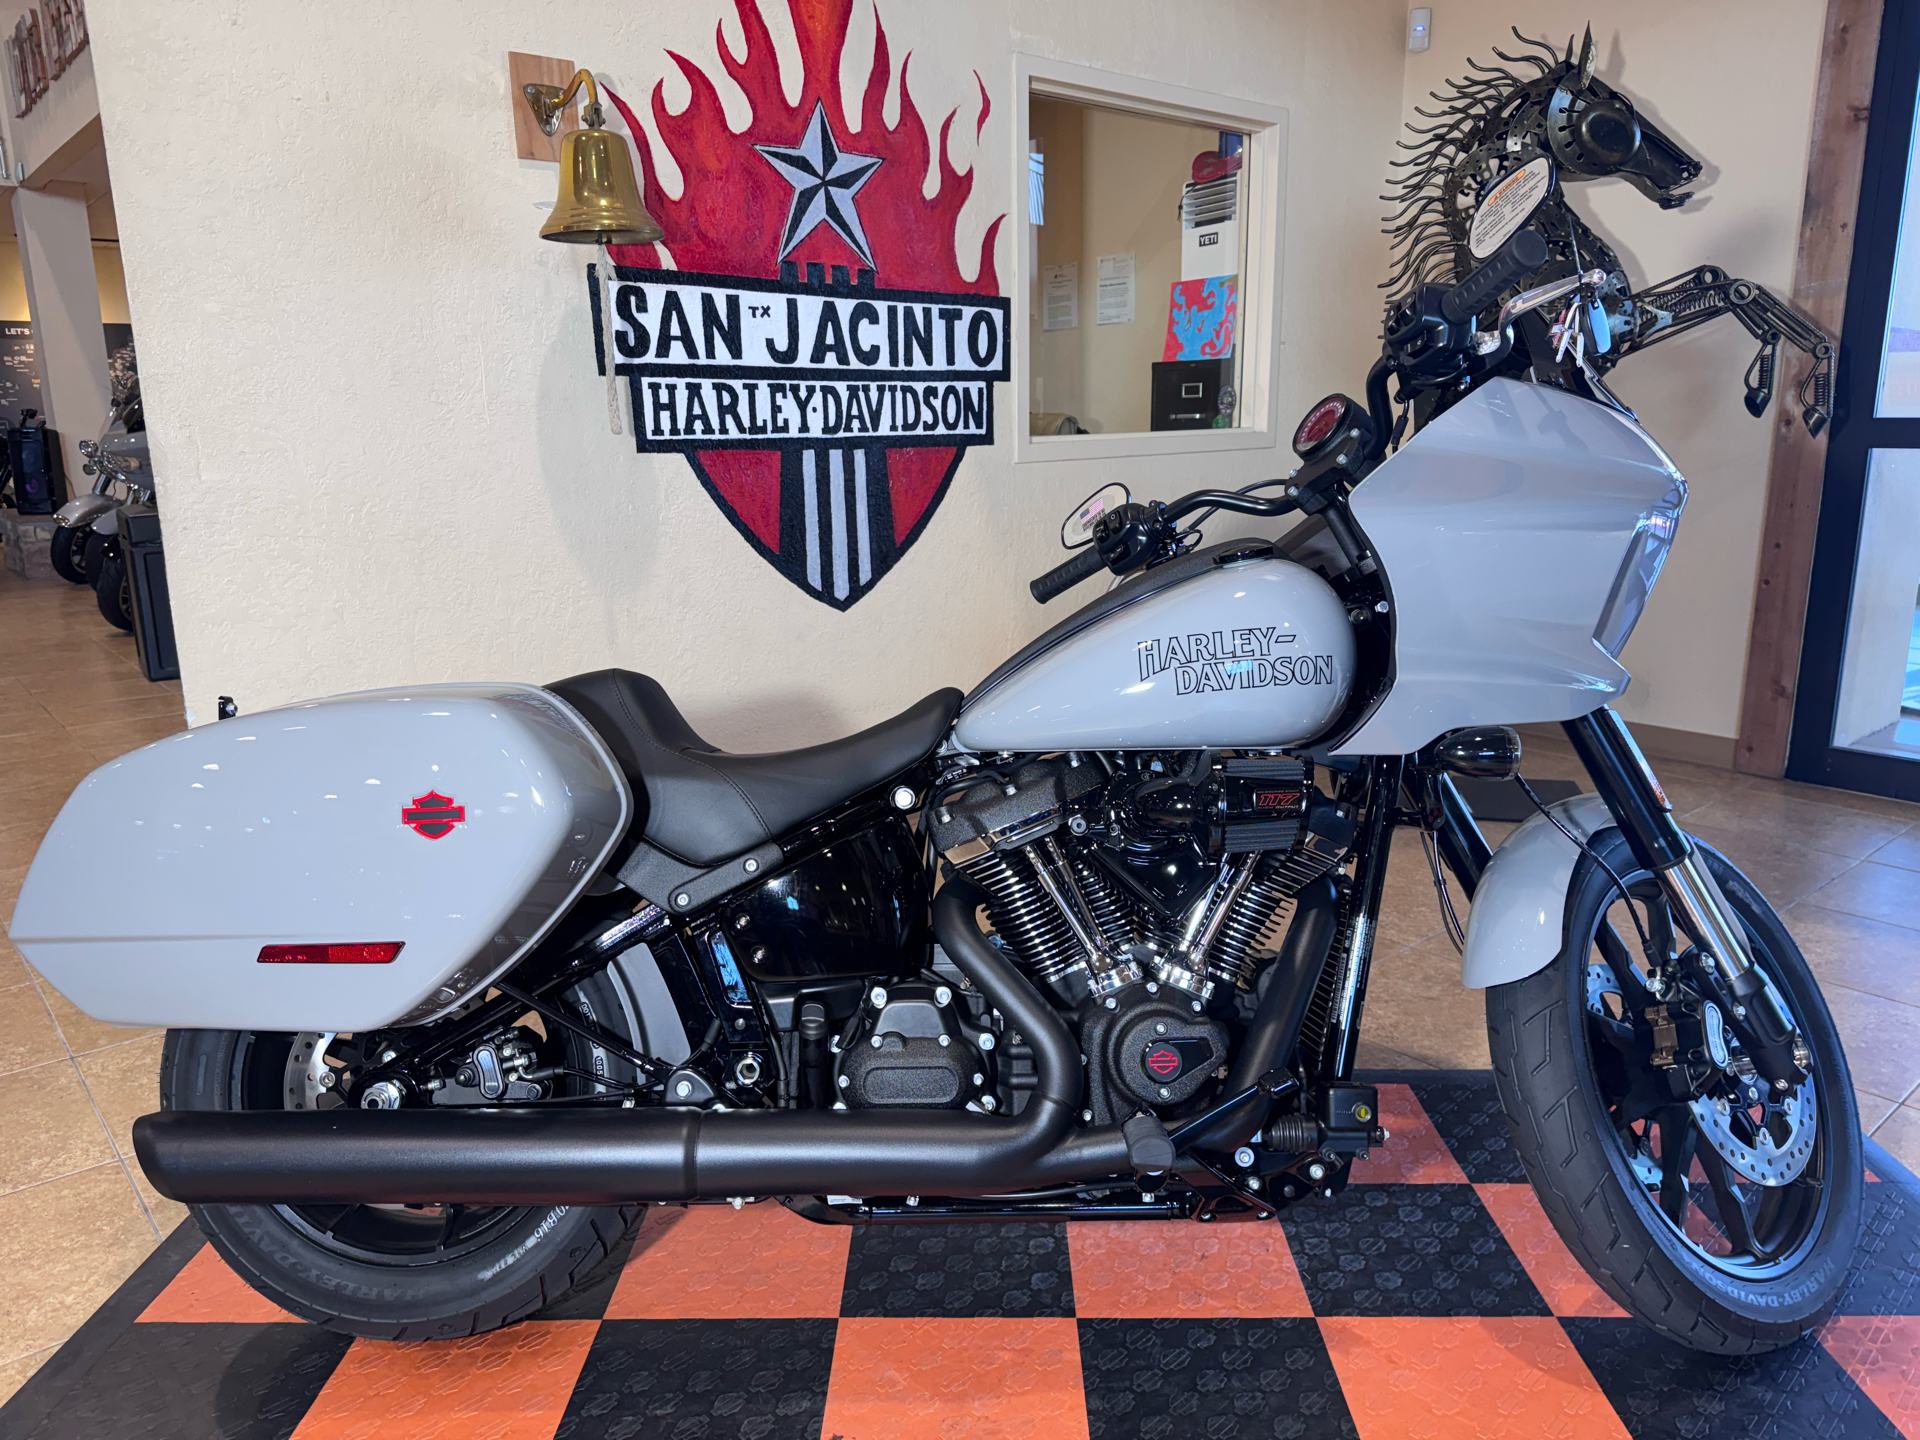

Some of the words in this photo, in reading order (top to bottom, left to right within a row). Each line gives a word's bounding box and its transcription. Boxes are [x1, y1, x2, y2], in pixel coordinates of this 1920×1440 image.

[1200, 235, 1217, 245] YETI
[5, 327, 30, 335] LET'S
[614, 284, 743, 359] SAN
[748, 305, 771, 319] TX
[765, 297, 998, 368] JACINTO
[1174, 655, 1333, 695] DAVIDSON
[1259, 793, 1300, 806] 117
